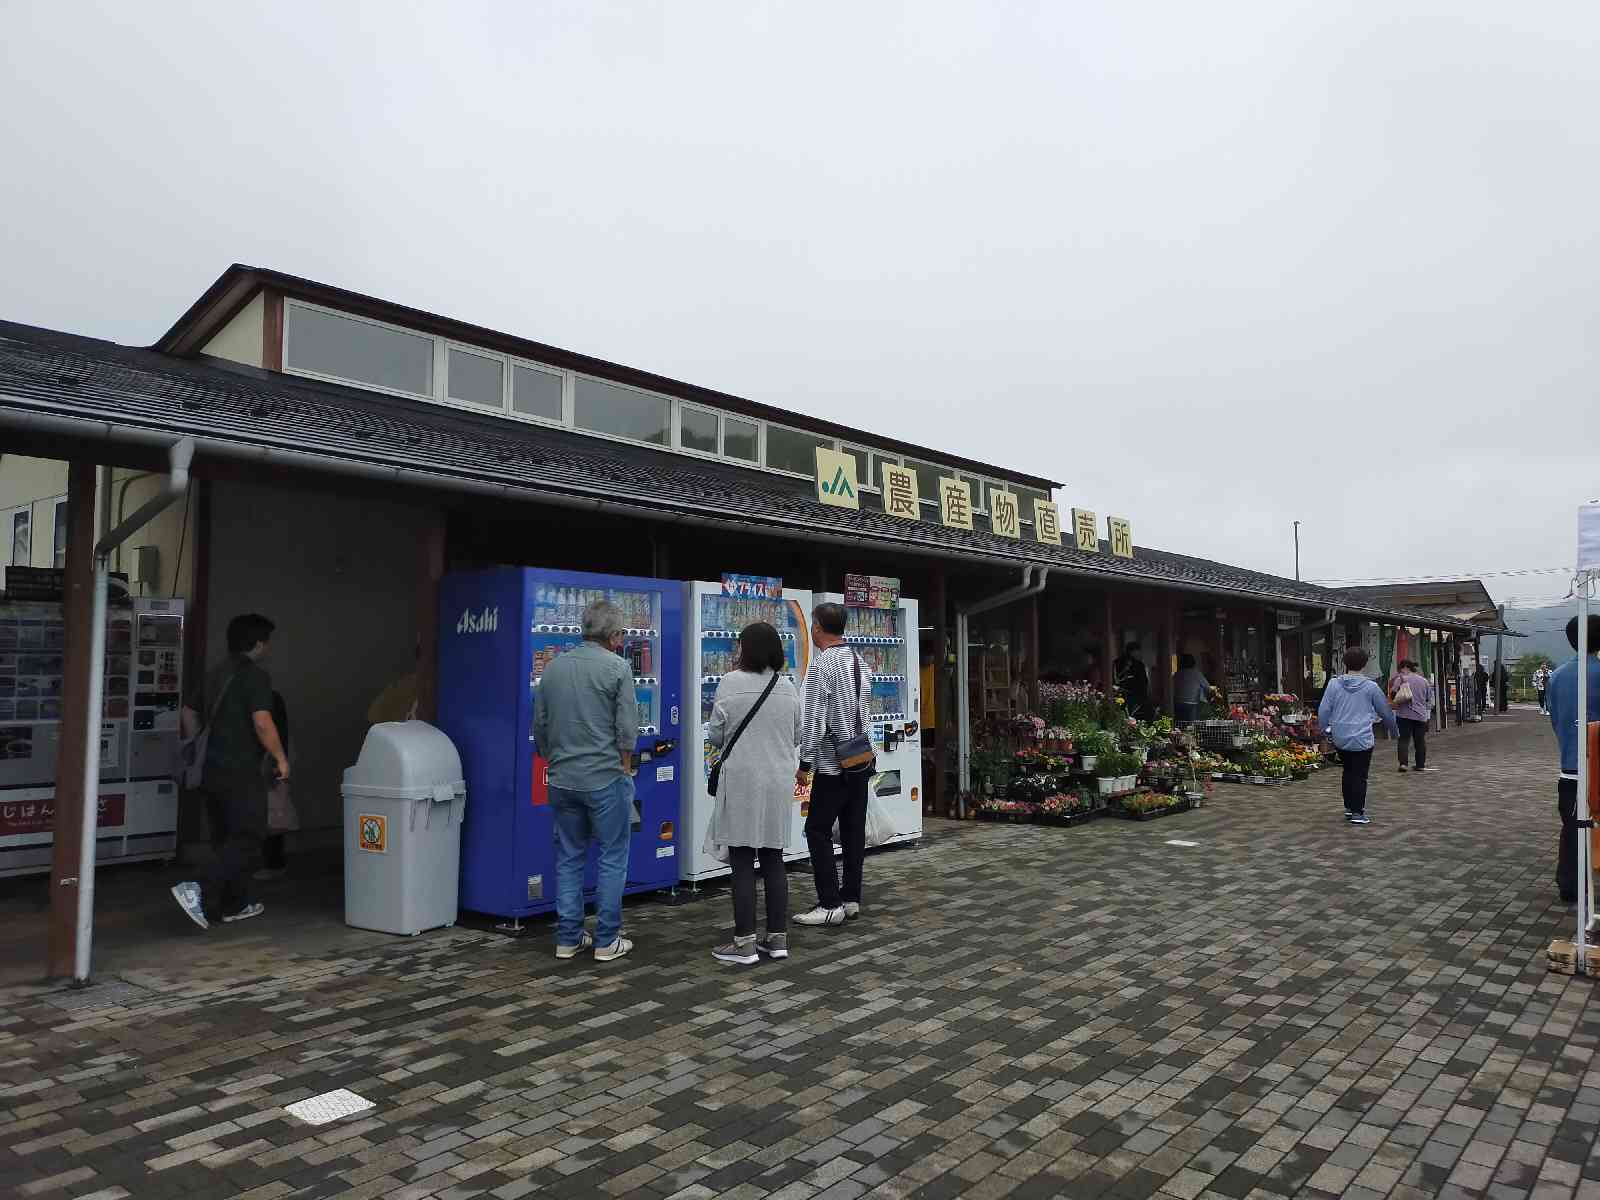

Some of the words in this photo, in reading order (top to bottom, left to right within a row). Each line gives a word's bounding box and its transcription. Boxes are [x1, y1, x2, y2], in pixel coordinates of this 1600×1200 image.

[888, 470, 1130, 555] 農産物直売所
[457, 607, 498, 633] Asahi
